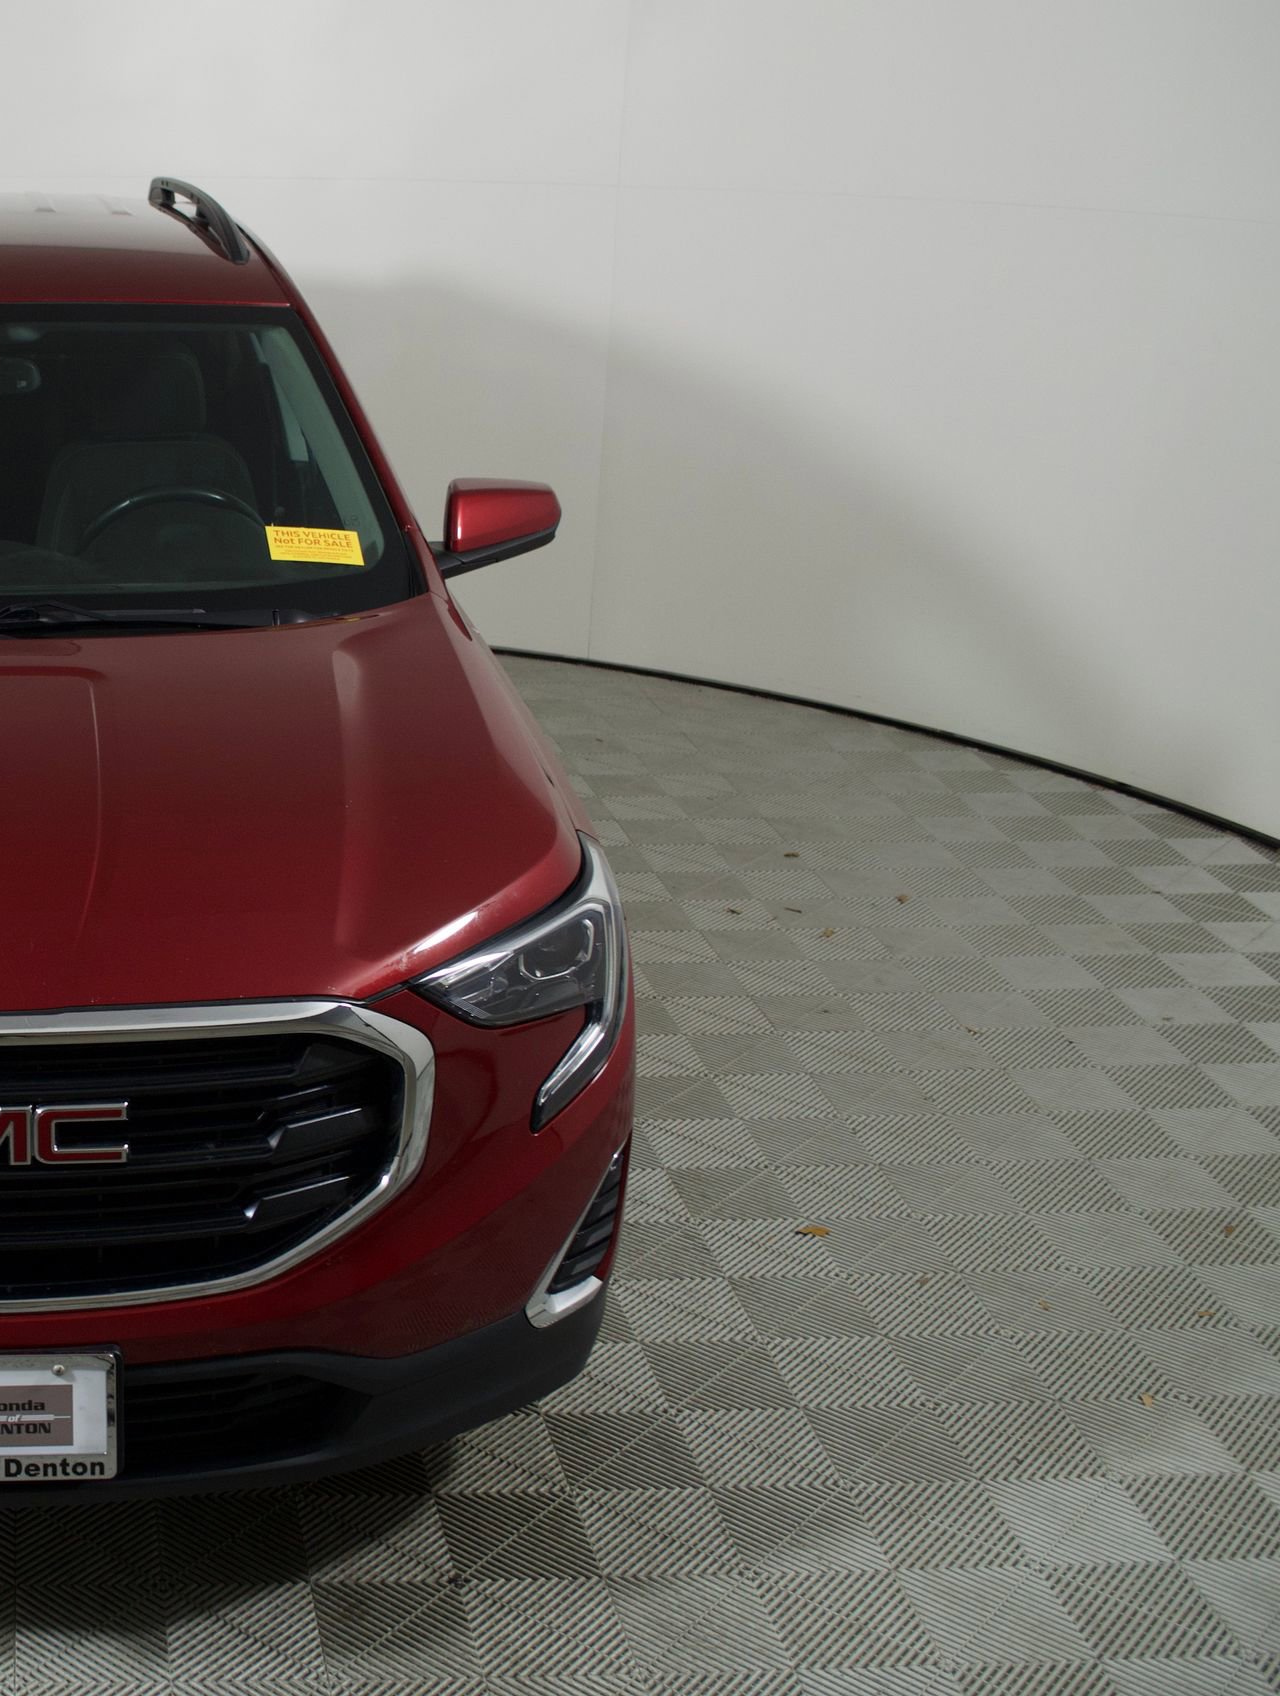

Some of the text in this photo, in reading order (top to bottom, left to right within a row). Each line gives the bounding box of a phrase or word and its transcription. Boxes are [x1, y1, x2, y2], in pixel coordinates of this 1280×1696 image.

[302, 531, 351, 541] VEHICLE
[298, 538, 321, 546] FOR
[323, 540, 353, 549] SALE
[7, 1414, 21, 1423] of
[4, 1458, 105, 1478] Denton
